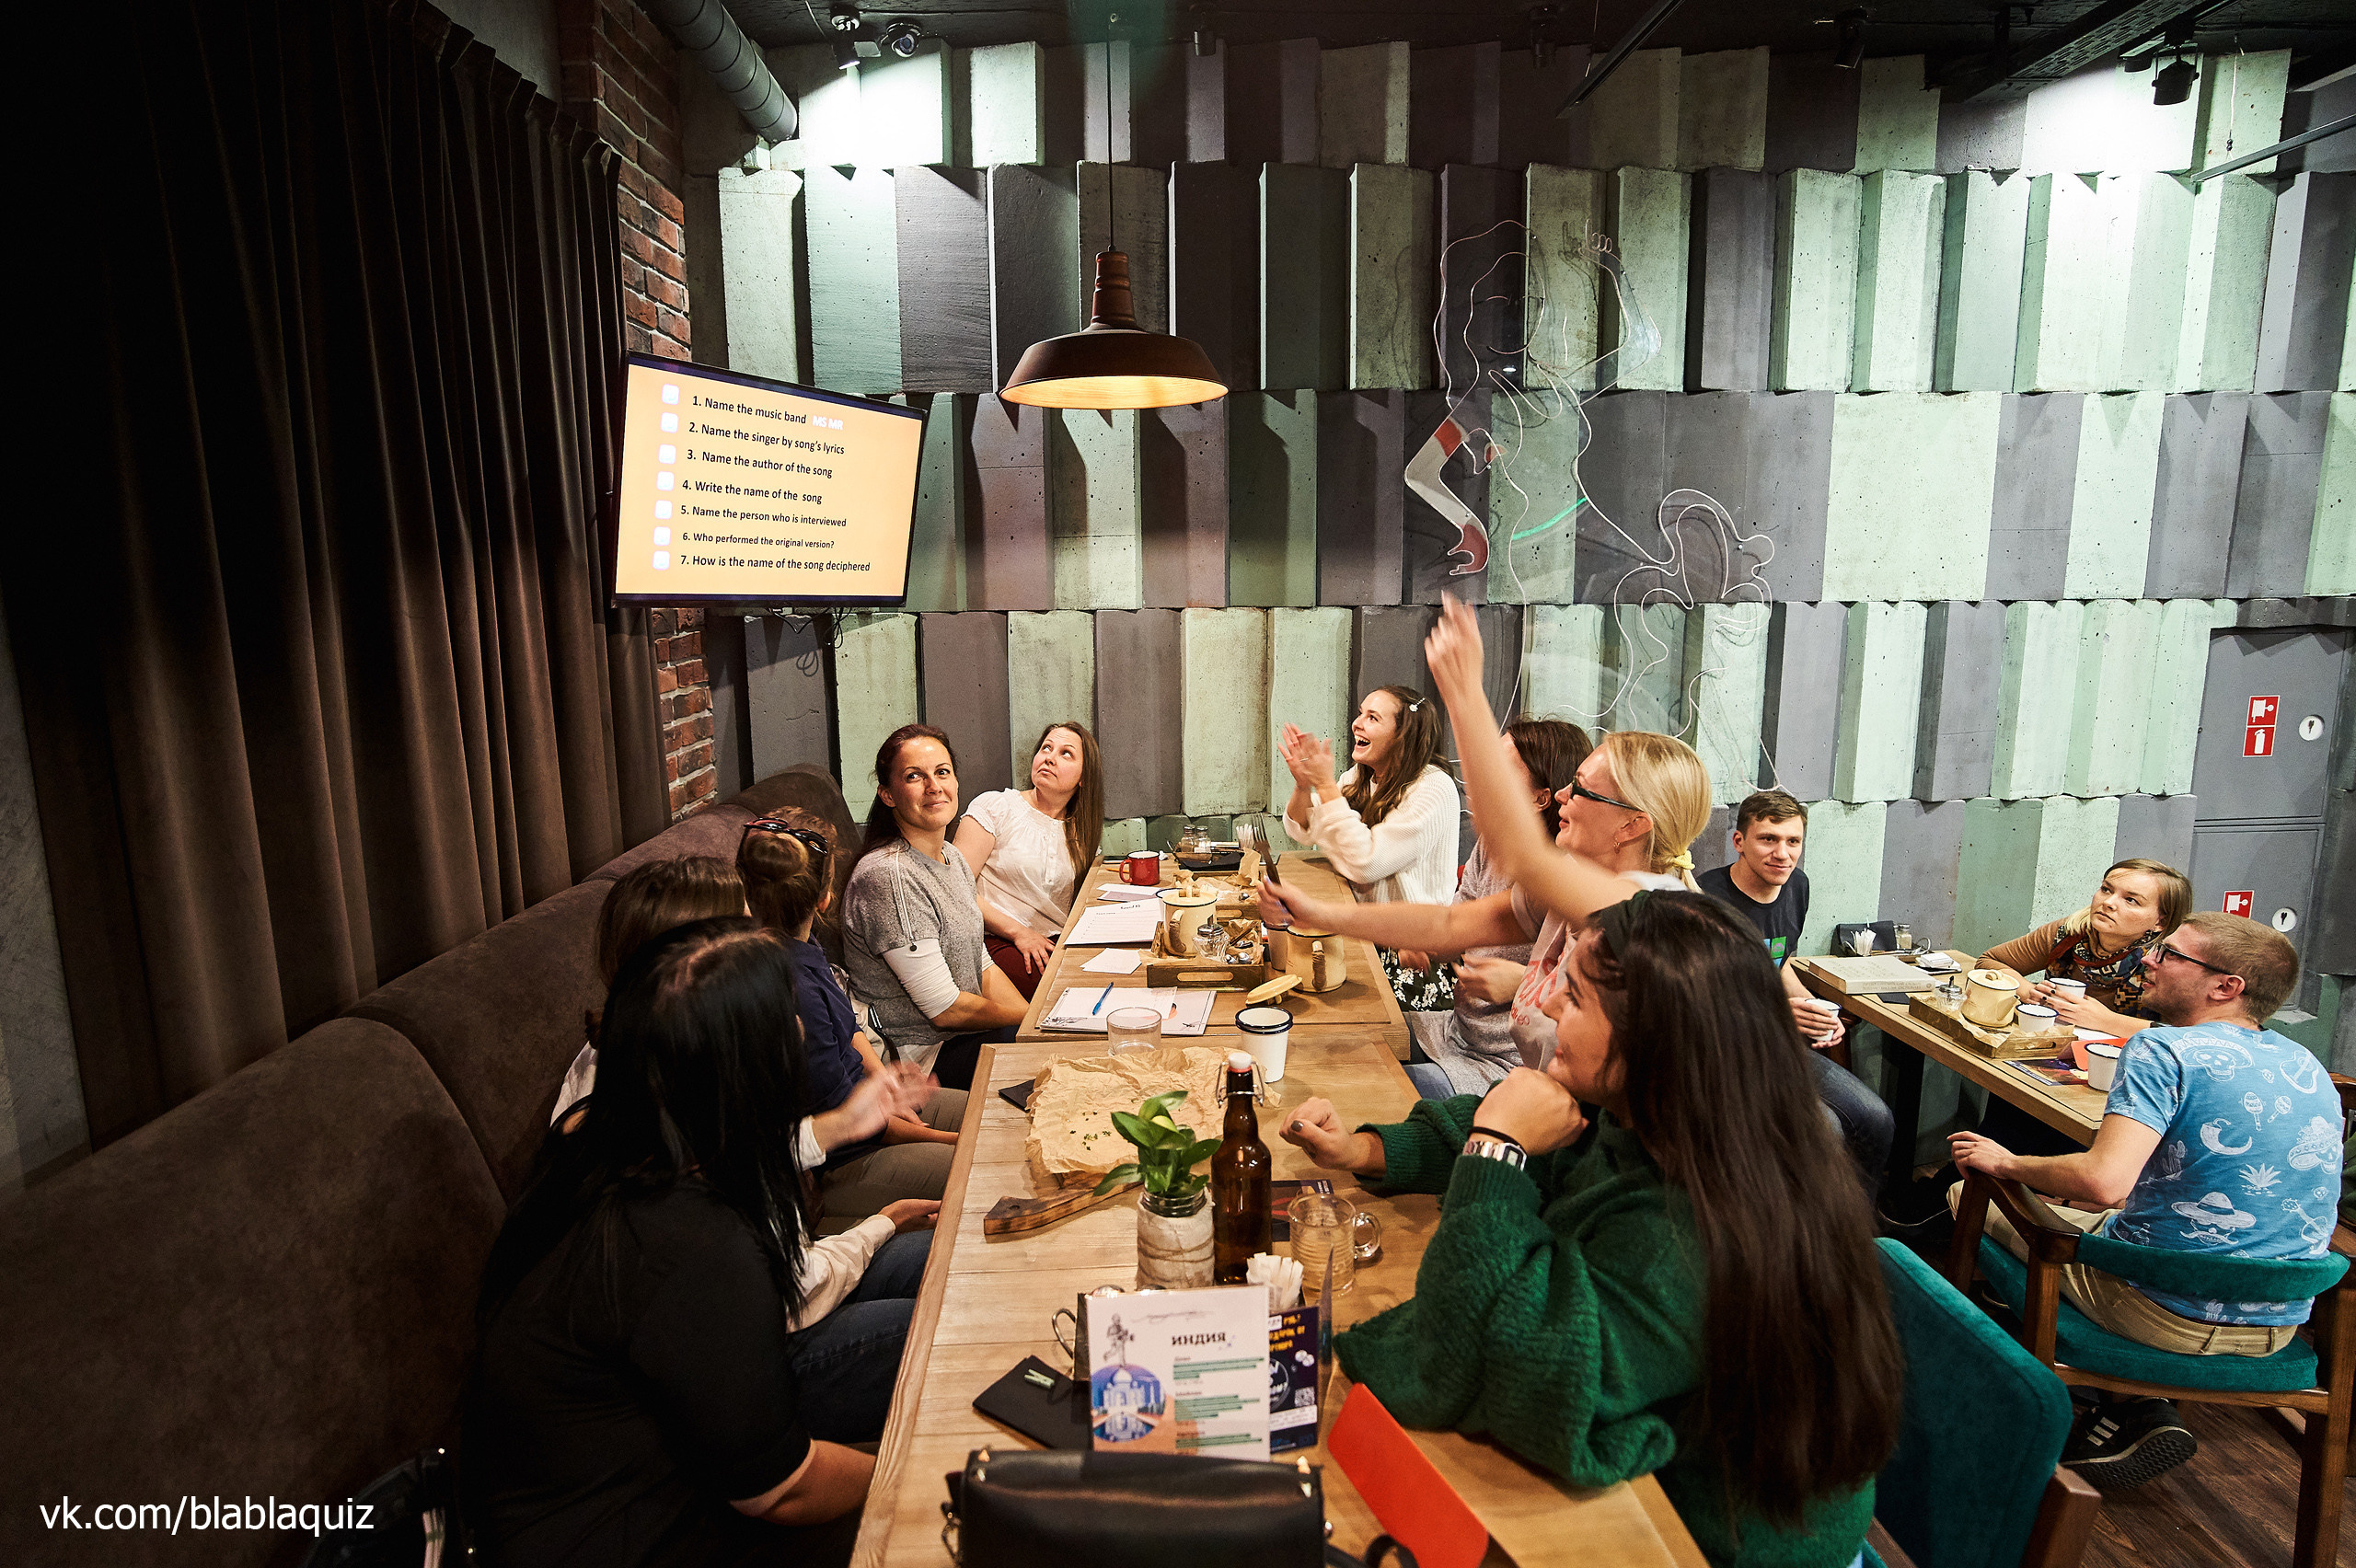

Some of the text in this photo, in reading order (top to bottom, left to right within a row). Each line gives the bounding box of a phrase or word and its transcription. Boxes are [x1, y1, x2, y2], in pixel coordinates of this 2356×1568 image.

[692, 395, 844, 431] 1. Name the music band MS MR
[688, 421, 699, 433] 2.
[701, 423, 732, 438] Name
[733, 429, 750, 441] the
[751, 432, 780, 446] singer
[781, 435, 793, 449] by
[823, 442, 845, 455] lyrics
[687, 448, 833, 479] 3. Name the author of the song
[682, 479, 823, 505] 4. Write the name of the song
[680, 504, 689, 515] 5.
[692, 505, 721, 517] Name
[722, 508, 738, 519] the
[739, 512, 770, 521] person
[771, 513, 791, 523] who
[800, 513, 847, 527] interviewed
[682, 532, 835, 548] 6. Who performed the original version?
[680, 554, 871, 572] 7. How is the name of the song deciphered
